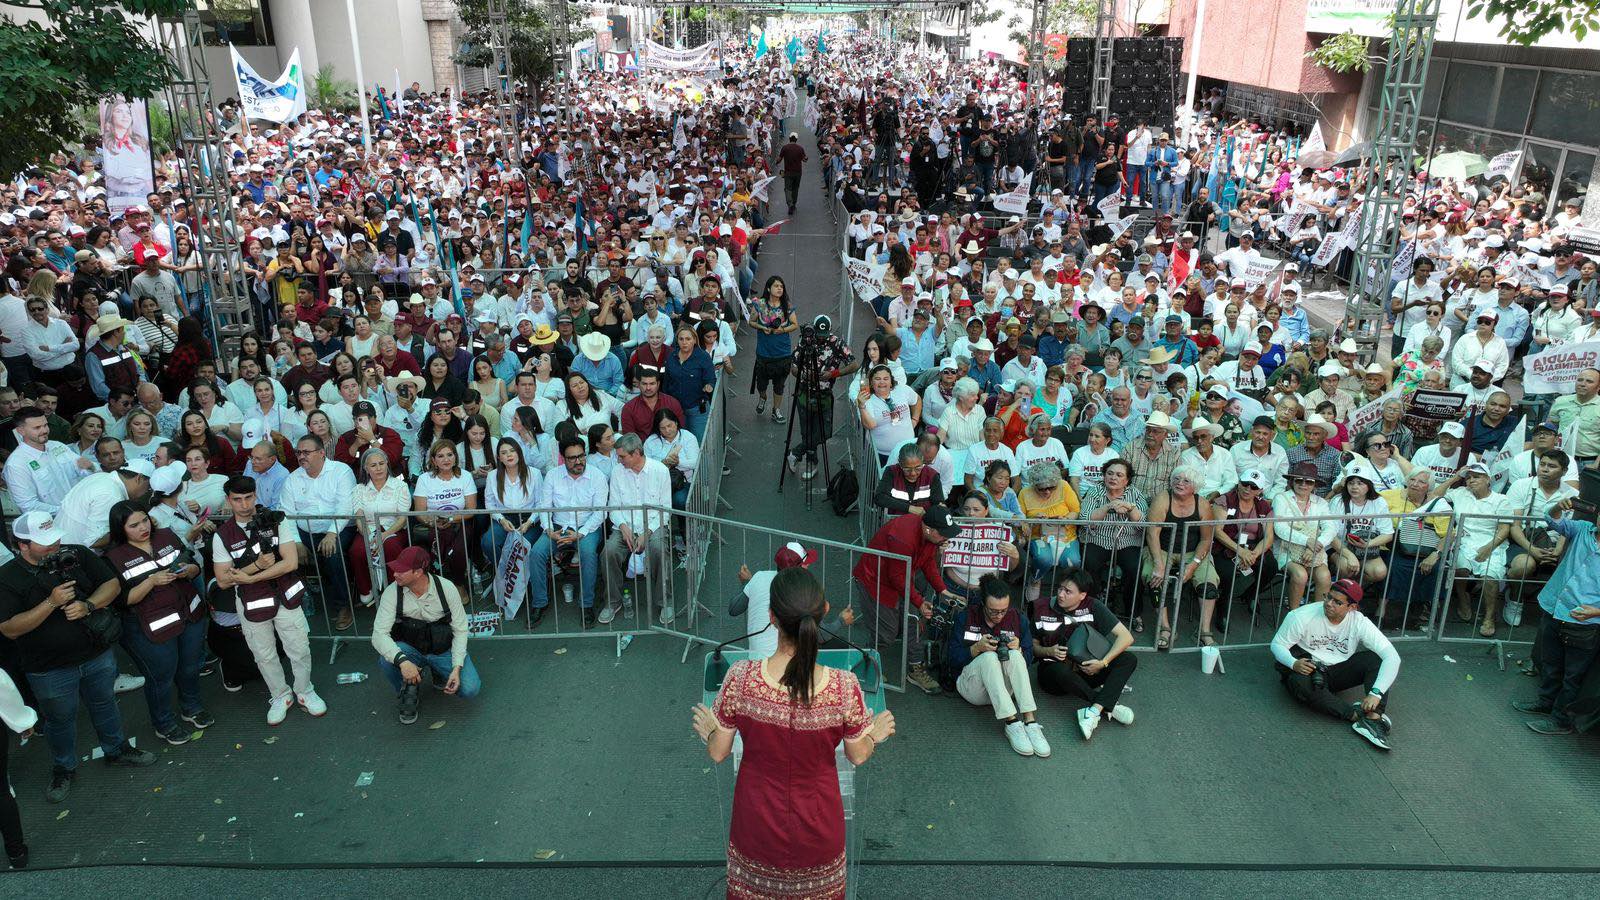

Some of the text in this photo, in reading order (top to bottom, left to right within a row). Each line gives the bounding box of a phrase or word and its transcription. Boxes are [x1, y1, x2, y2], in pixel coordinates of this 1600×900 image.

[819, 322, 827, 331] C
[1425, 404, 1456, 415] Claudia
[246, 431, 254, 439] C
[974, 529, 983, 539] DE
[957, 542, 994, 552] Y PALABRA
